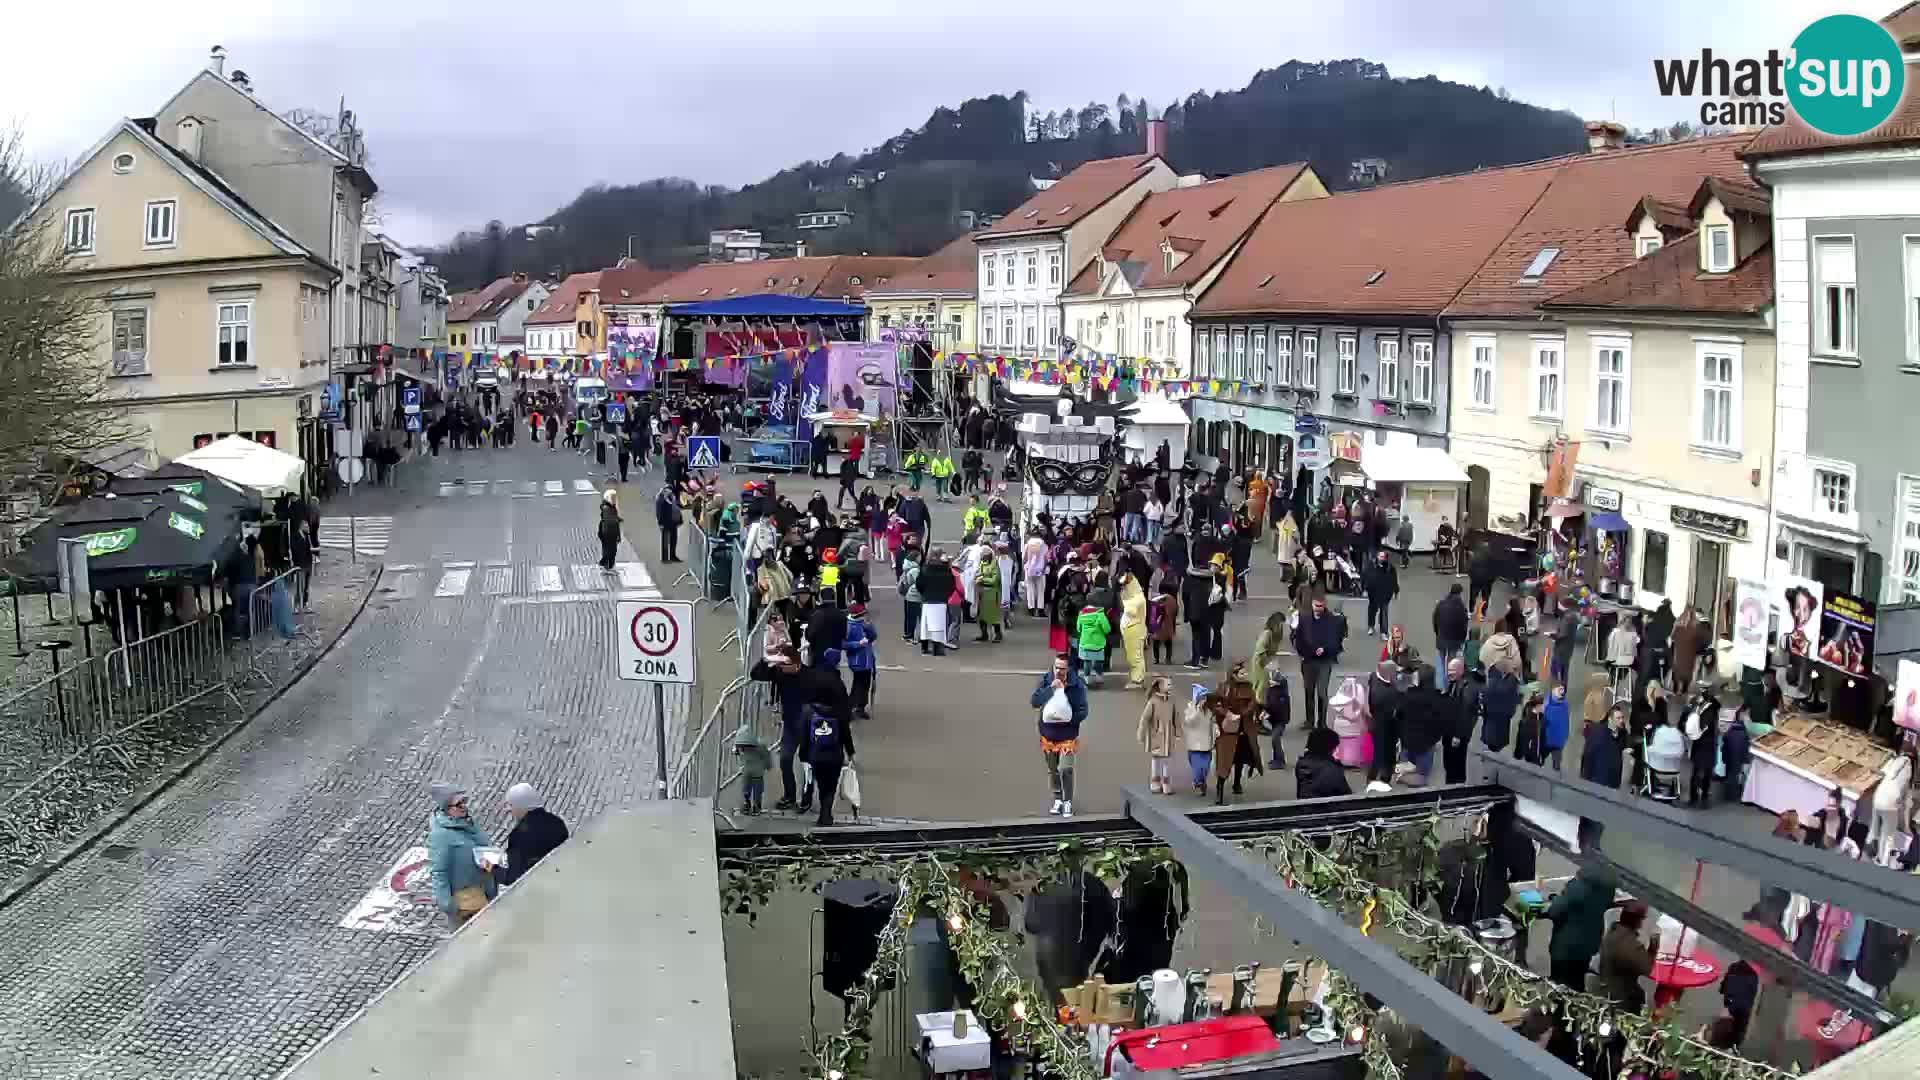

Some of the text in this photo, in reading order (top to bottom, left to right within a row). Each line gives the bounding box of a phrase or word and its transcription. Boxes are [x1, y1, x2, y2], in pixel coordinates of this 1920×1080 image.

[407, 391, 416, 403] P
[643, 622, 668, 643] 30
[633, 659, 679, 677] ZONA
